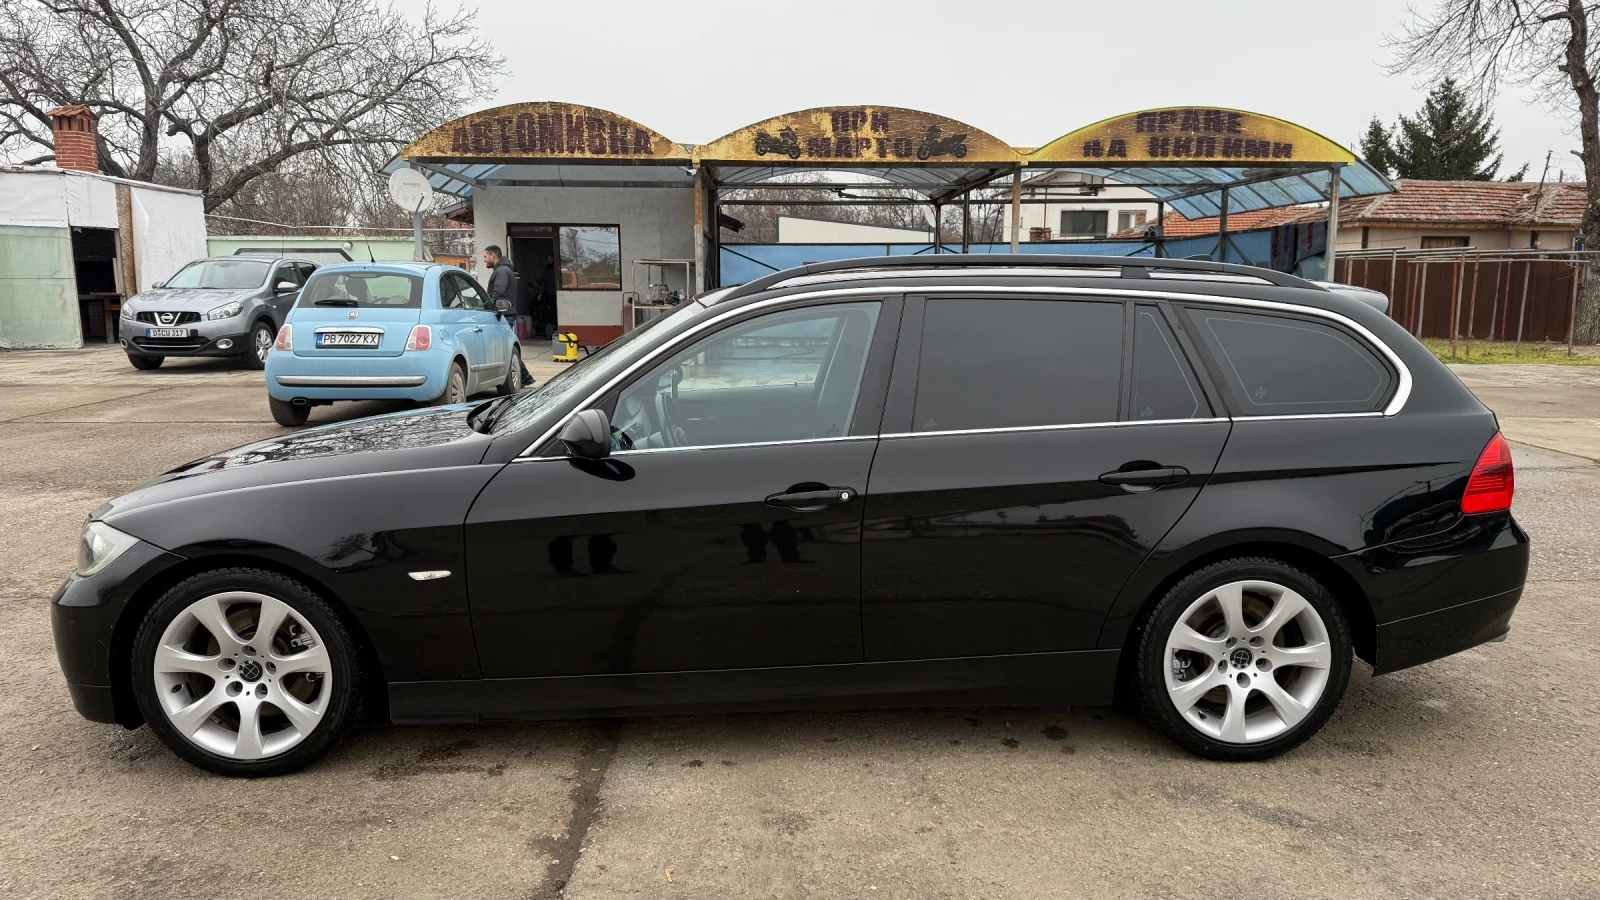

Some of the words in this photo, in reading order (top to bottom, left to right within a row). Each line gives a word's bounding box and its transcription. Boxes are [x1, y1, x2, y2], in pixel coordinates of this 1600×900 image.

[832, 111, 888, 132] ПРИ
[1136, 109, 1242, 133] ПРАНЕ
[453, 112, 653, 154] АВТОМИВКА
[1083, 137, 1127, 158] НА
[172, 329, 184, 337] 317
[323, 334, 337, 344] PB
[338, 334, 363, 344] 7027
[363, 334, 377, 344] KX
